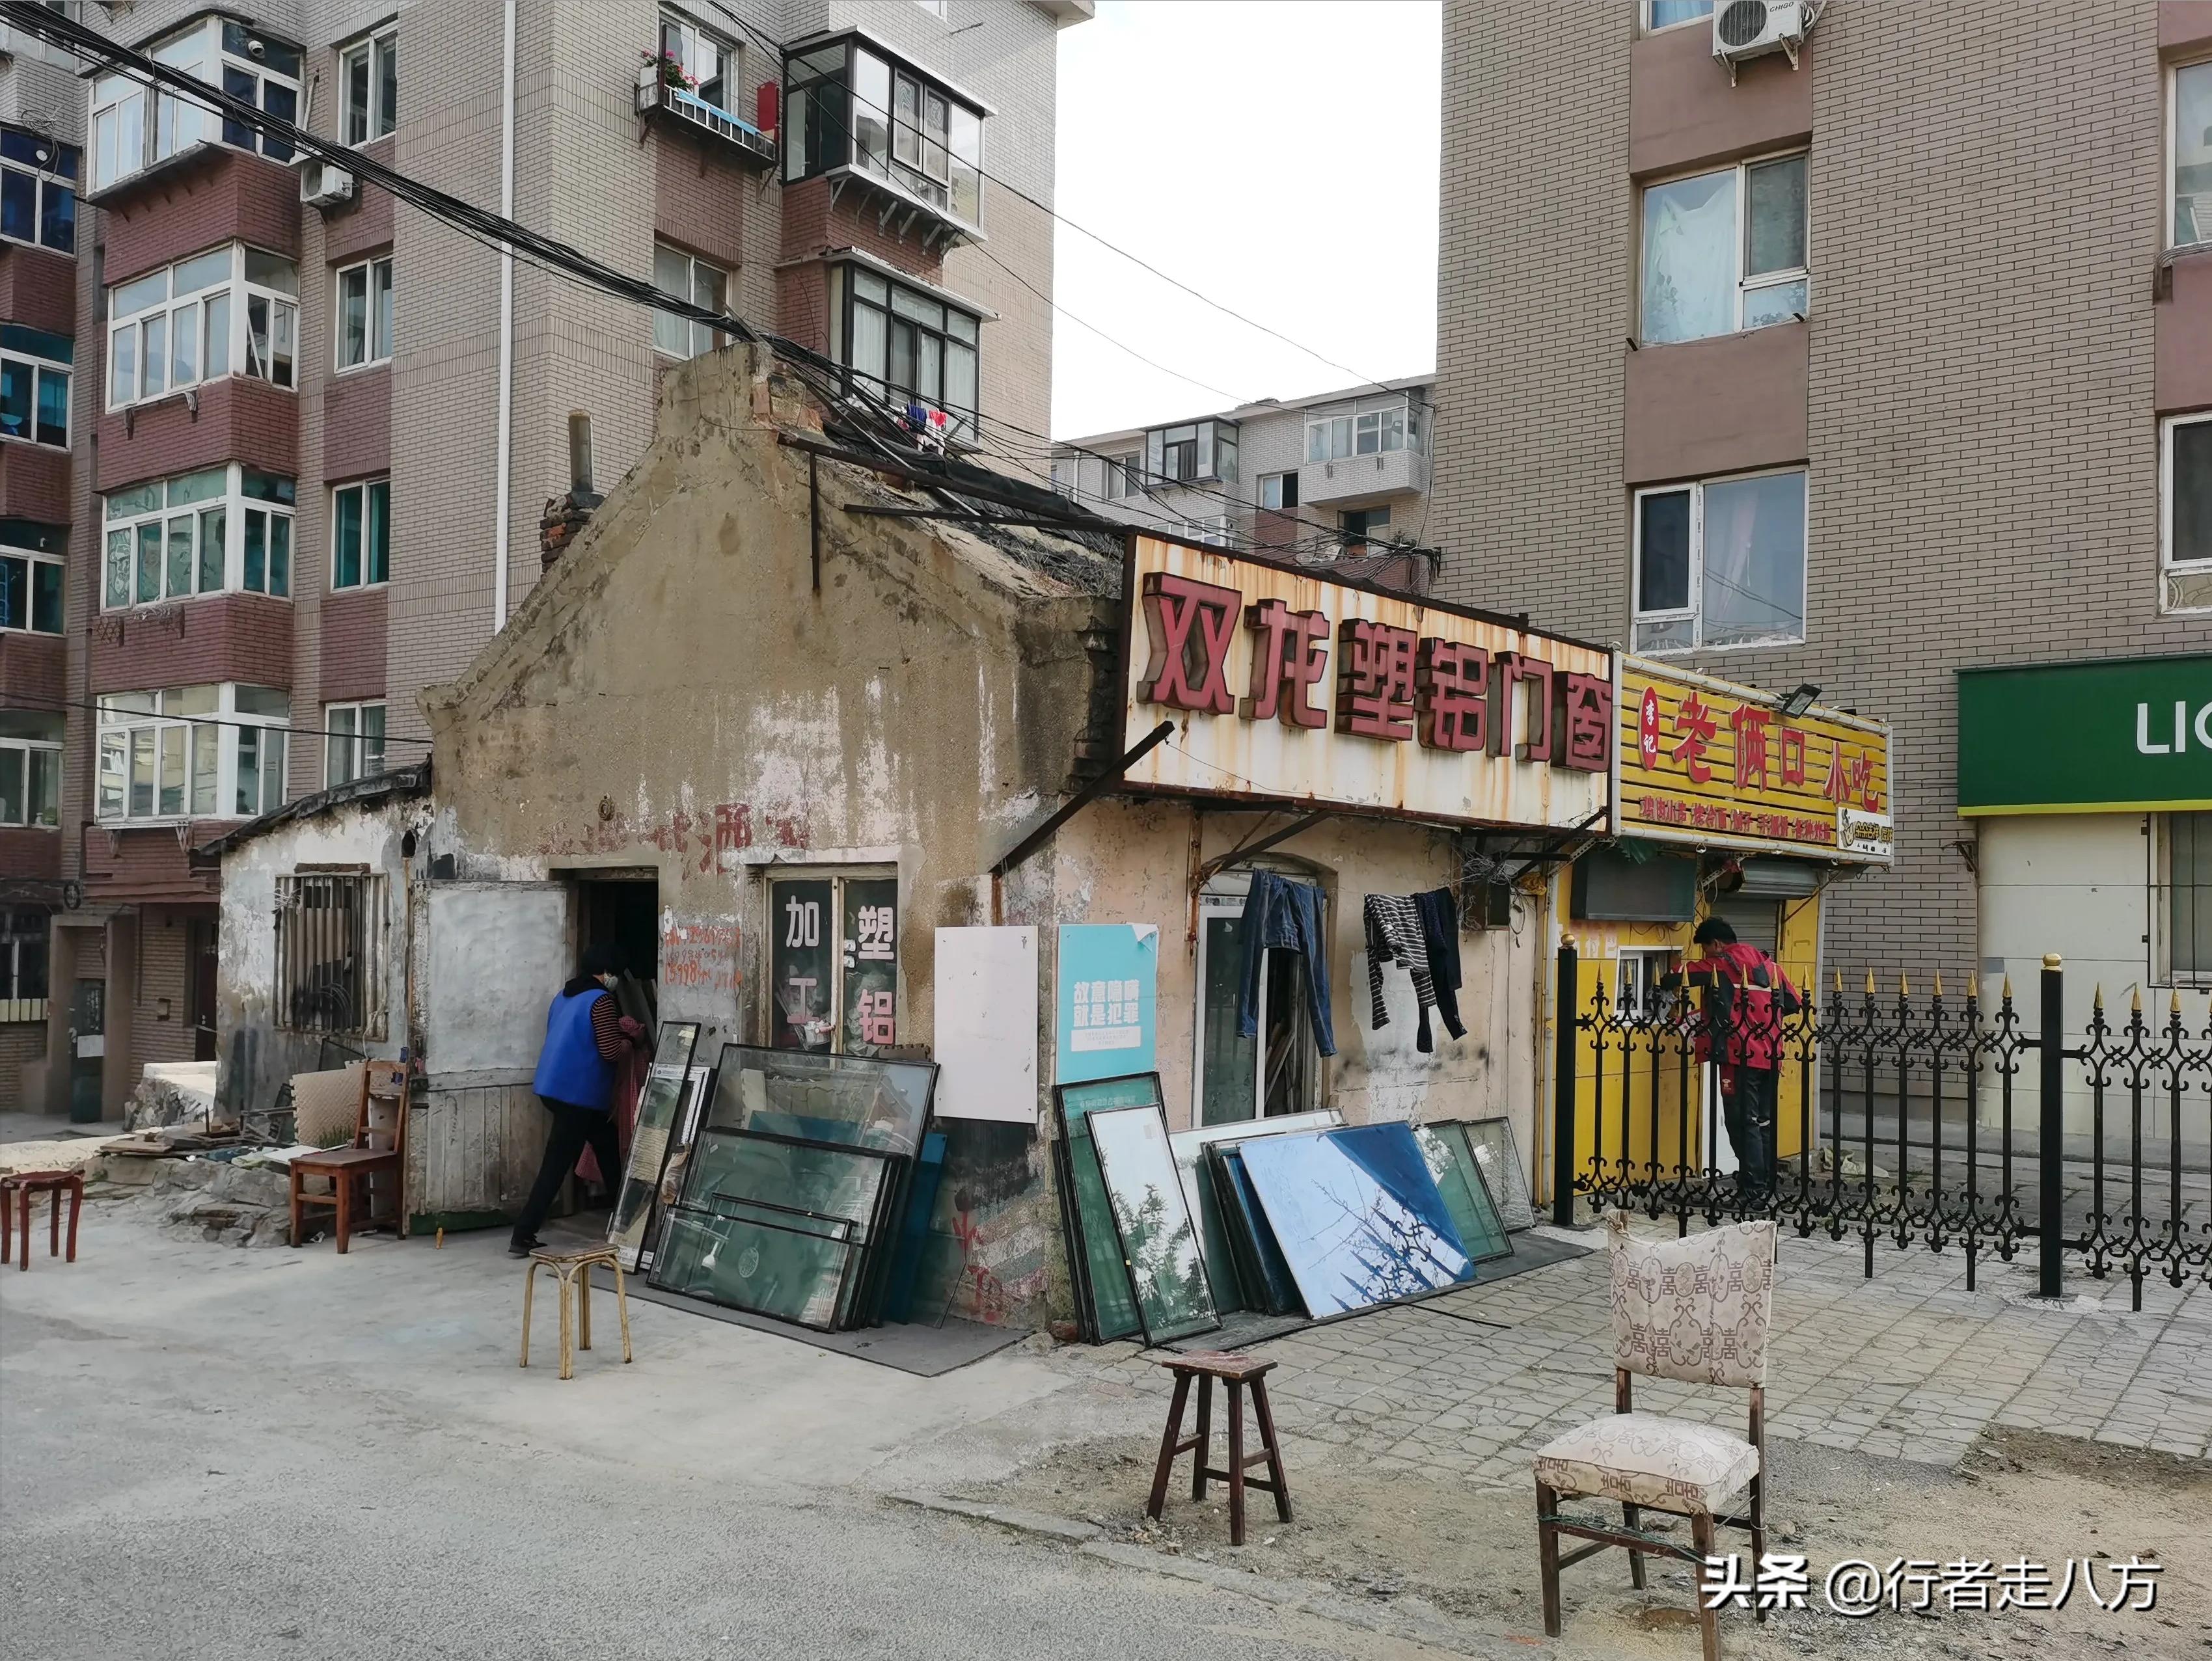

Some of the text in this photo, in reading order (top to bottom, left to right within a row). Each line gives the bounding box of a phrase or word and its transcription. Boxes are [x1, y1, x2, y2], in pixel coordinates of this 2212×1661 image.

[1769, 1, 1794, 12] CHIGO
[1137, 571, 1613, 773] 双龙塑铝门窗
[785, 895, 820, 1025] 加工
[857, 905, 895, 1045] 塑铝
[1073, 1002, 1140, 1027] 就是犯罪
